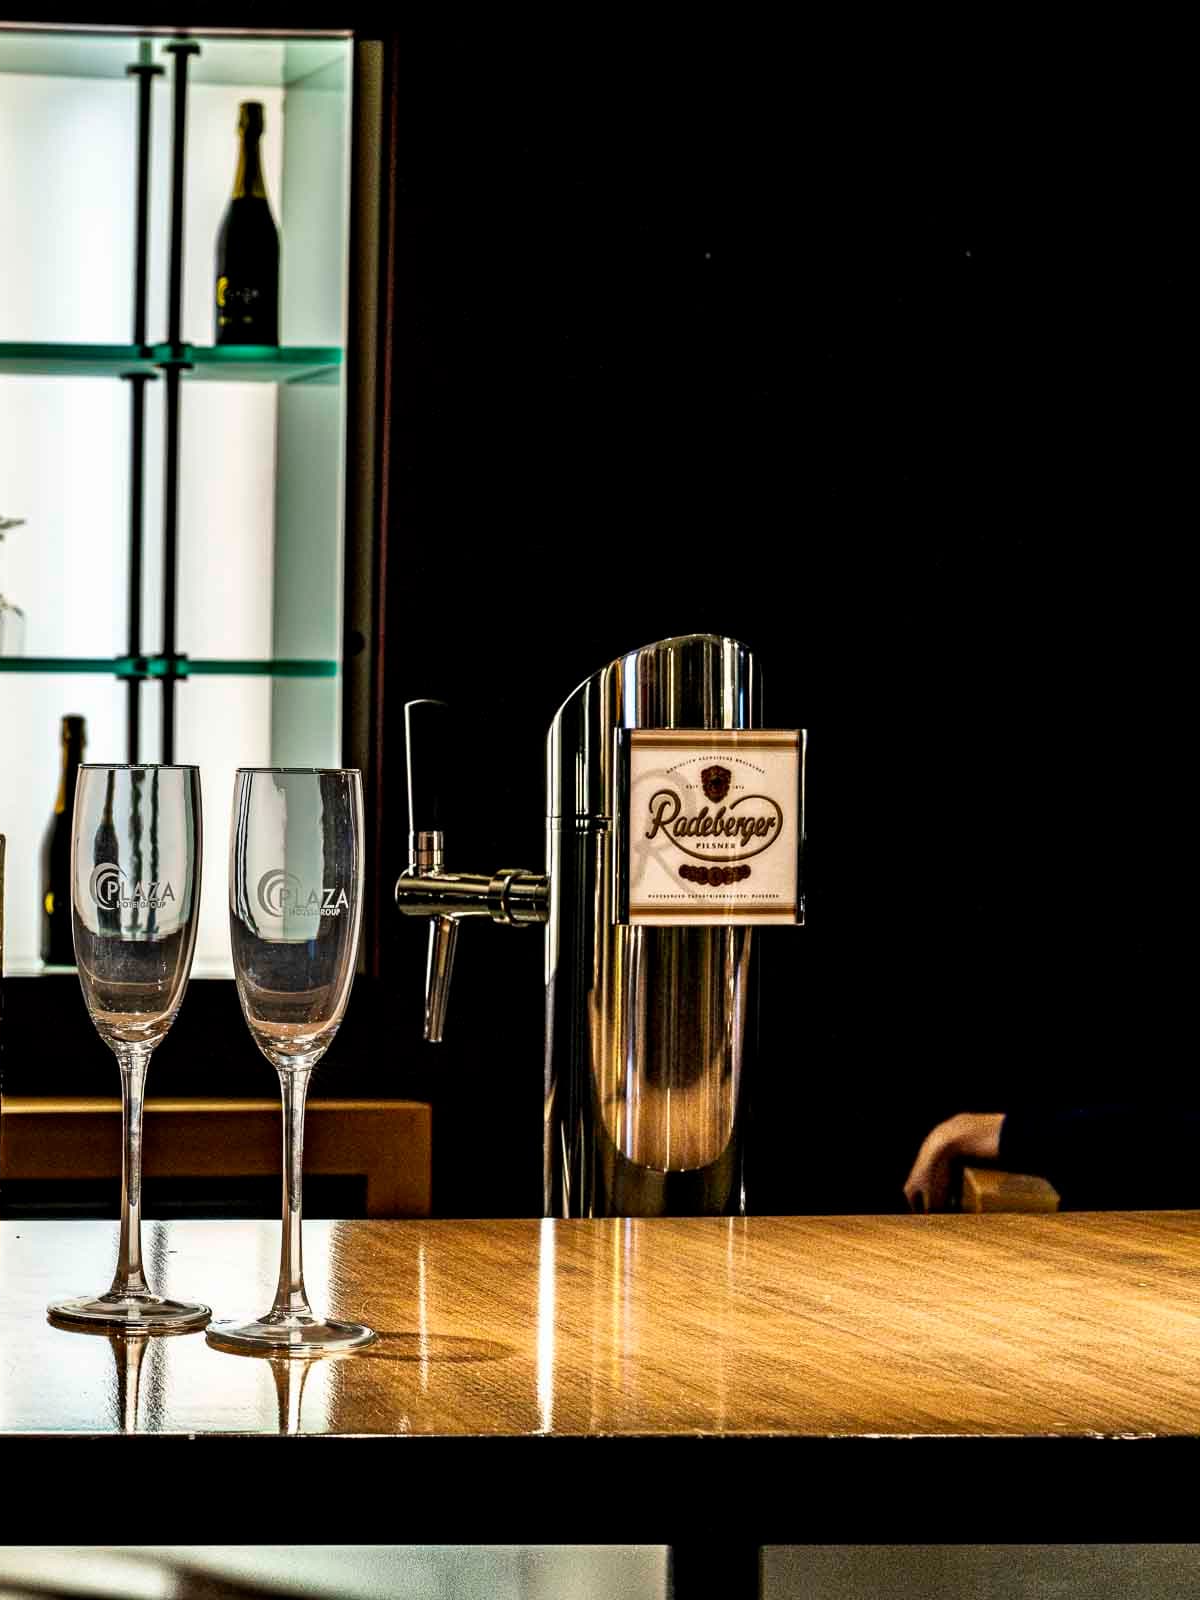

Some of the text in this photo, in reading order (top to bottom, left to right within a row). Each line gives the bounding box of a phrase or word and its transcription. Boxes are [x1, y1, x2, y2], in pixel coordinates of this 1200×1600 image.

[646, 789, 782, 849] Radeberger
[106, 881, 175, 901] PLAZA
[280, 887, 349, 909] PLAZA
